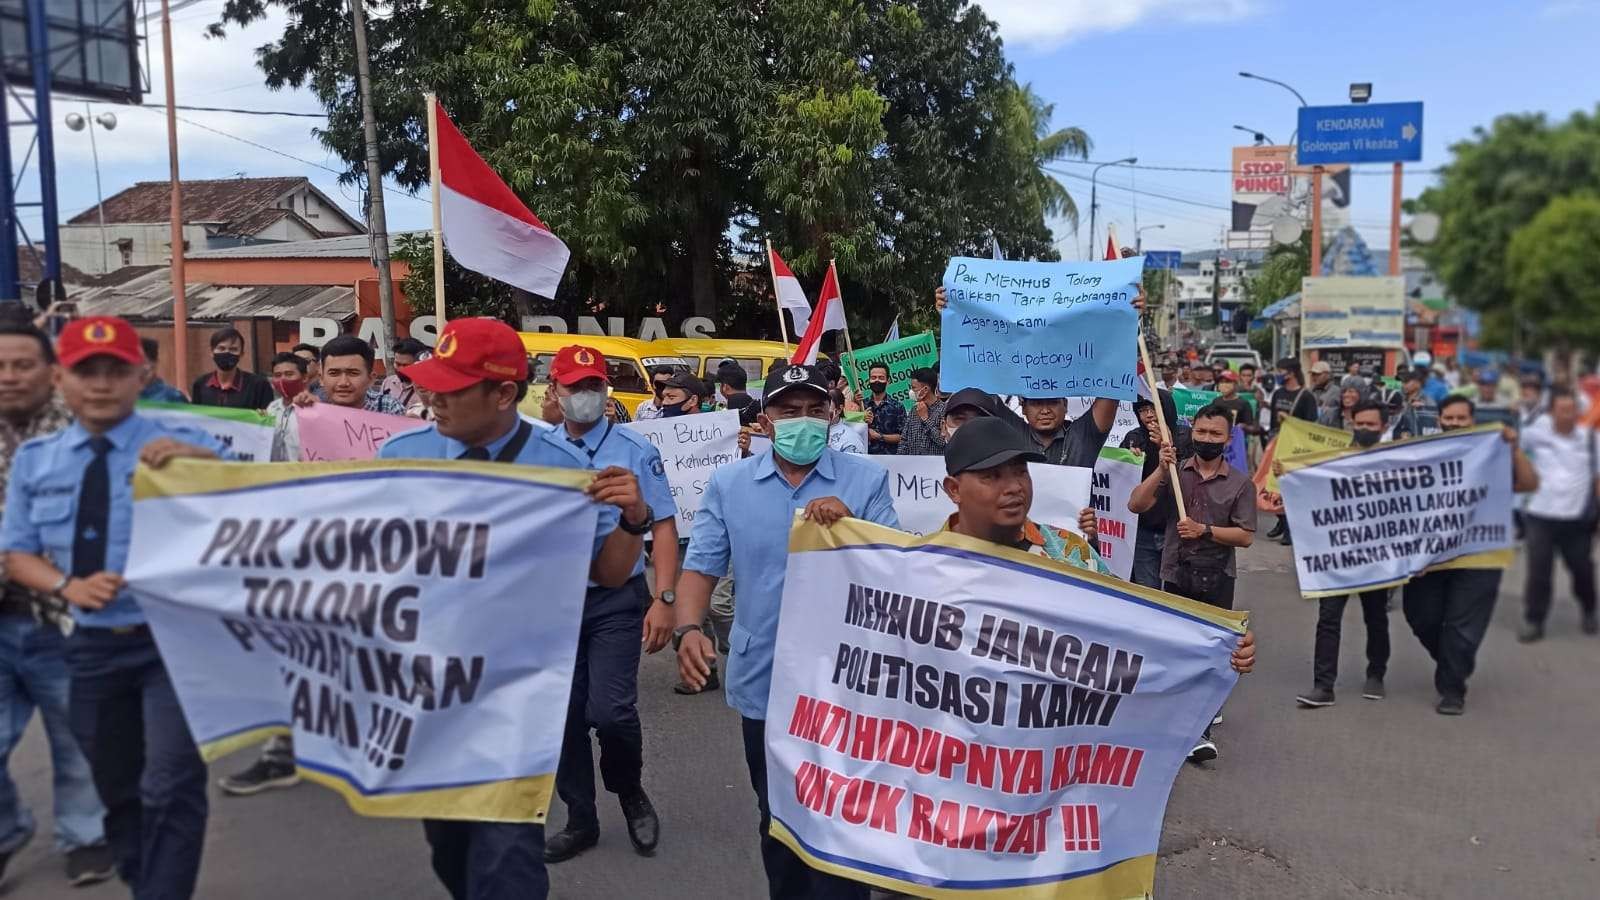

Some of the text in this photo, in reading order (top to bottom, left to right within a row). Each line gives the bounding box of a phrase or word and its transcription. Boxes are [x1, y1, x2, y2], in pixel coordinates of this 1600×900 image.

[1316, 117, 1385, 132] KENDARAAN
[1302, 139, 1350, 154] Golongan
[1353, 138, 1363, 150] VI
[1365, 138, 1399, 150] keatas
[1242, 162, 1284, 175] STOP
[953, 264, 1103, 289] Pak MENHUB Tolong
[959, 344, 1003, 364] Tidak
[1011, 349, 1073, 368] dipotong
[1021, 376, 1058, 391] Tidak
[673, 423, 723, 443] Butuh
[897, 472, 944, 500] MEN
[1330, 460, 1464, 502] MENHUB !!!
[1311, 484, 1489, 528] KAMI SUDAH LAKUKAN
[1098, 517, 1126, 539] AMI
[1328, 516, 1420, 548] KEWAJIBAN
[1422, 513, 1465, 535] KAMI
[199, 517, 490, 578] PAK JOKOWI
[1302, 554, 1338, 574] TAPI
[1340, 545, 1390, 569] MANA
[1424, 532, 1464, 556] KAMI
[243, 576, 422, 643] TOLONG
[845, 582, 1145, 695] MENHUB JANGAN
[831, 642, 1123, 728] POLITISASI KAMI
[788, 695, 1145, 796] MATI HIDUPNYA KAMI
[794, 761, 1102, 855] UNTUK RAKYAT !!!
